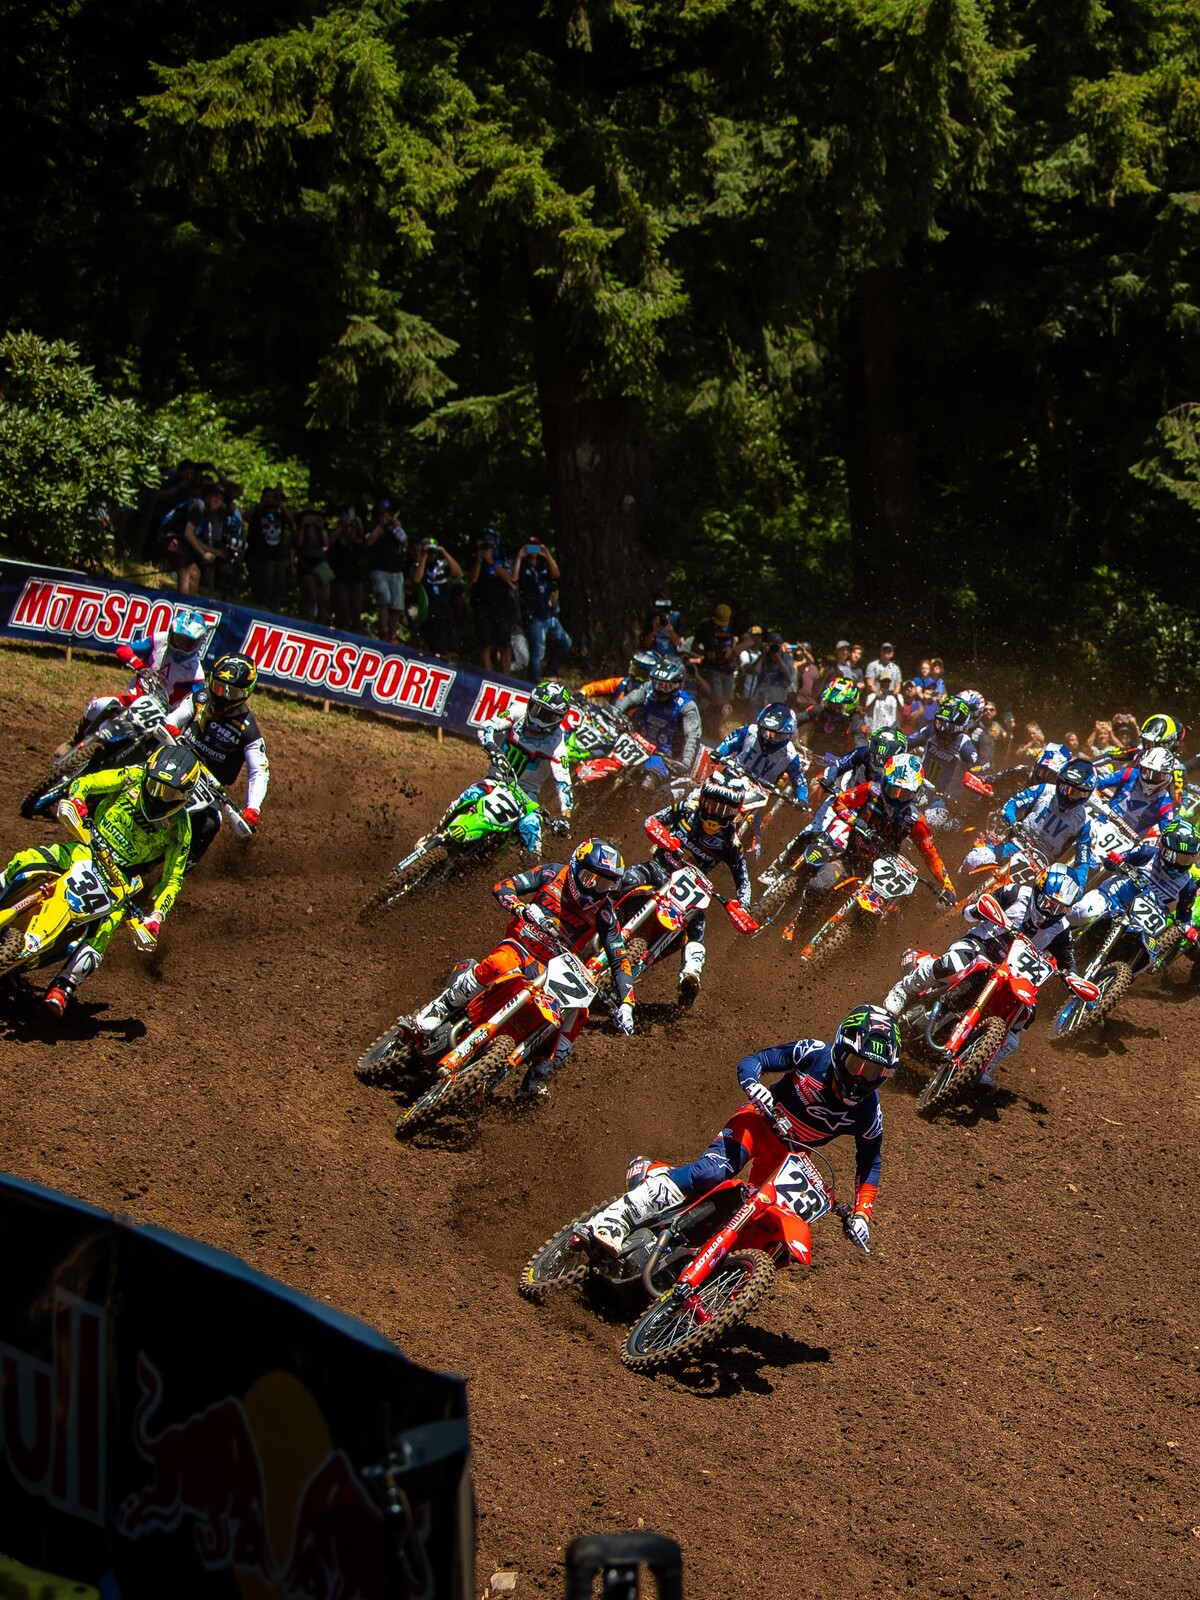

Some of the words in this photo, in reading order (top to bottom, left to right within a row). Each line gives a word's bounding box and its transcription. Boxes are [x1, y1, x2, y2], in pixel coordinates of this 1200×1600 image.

[13, 579, 217, 644] MOTOSPO
[129, 699, 160, 729] 246
[484, 793, 519, 824] 3
[1034, 805, 1070, 839] FLY
[1098, 832, 1124, 853] 97
[65, 869, 111, 915] 34
[669, 873, 706, 910] 51
[874, 864, 913, 897] 25
[159, 893, 174, 915] THOR
[1133, 903, 1165, 934] 29
[1017, 951, 1048, 986] 94
[548, 971, 589, 1007] 2
[776, 1170, 823, 1222] 23
[694, 1234, 724, 1272] DUNLOP
